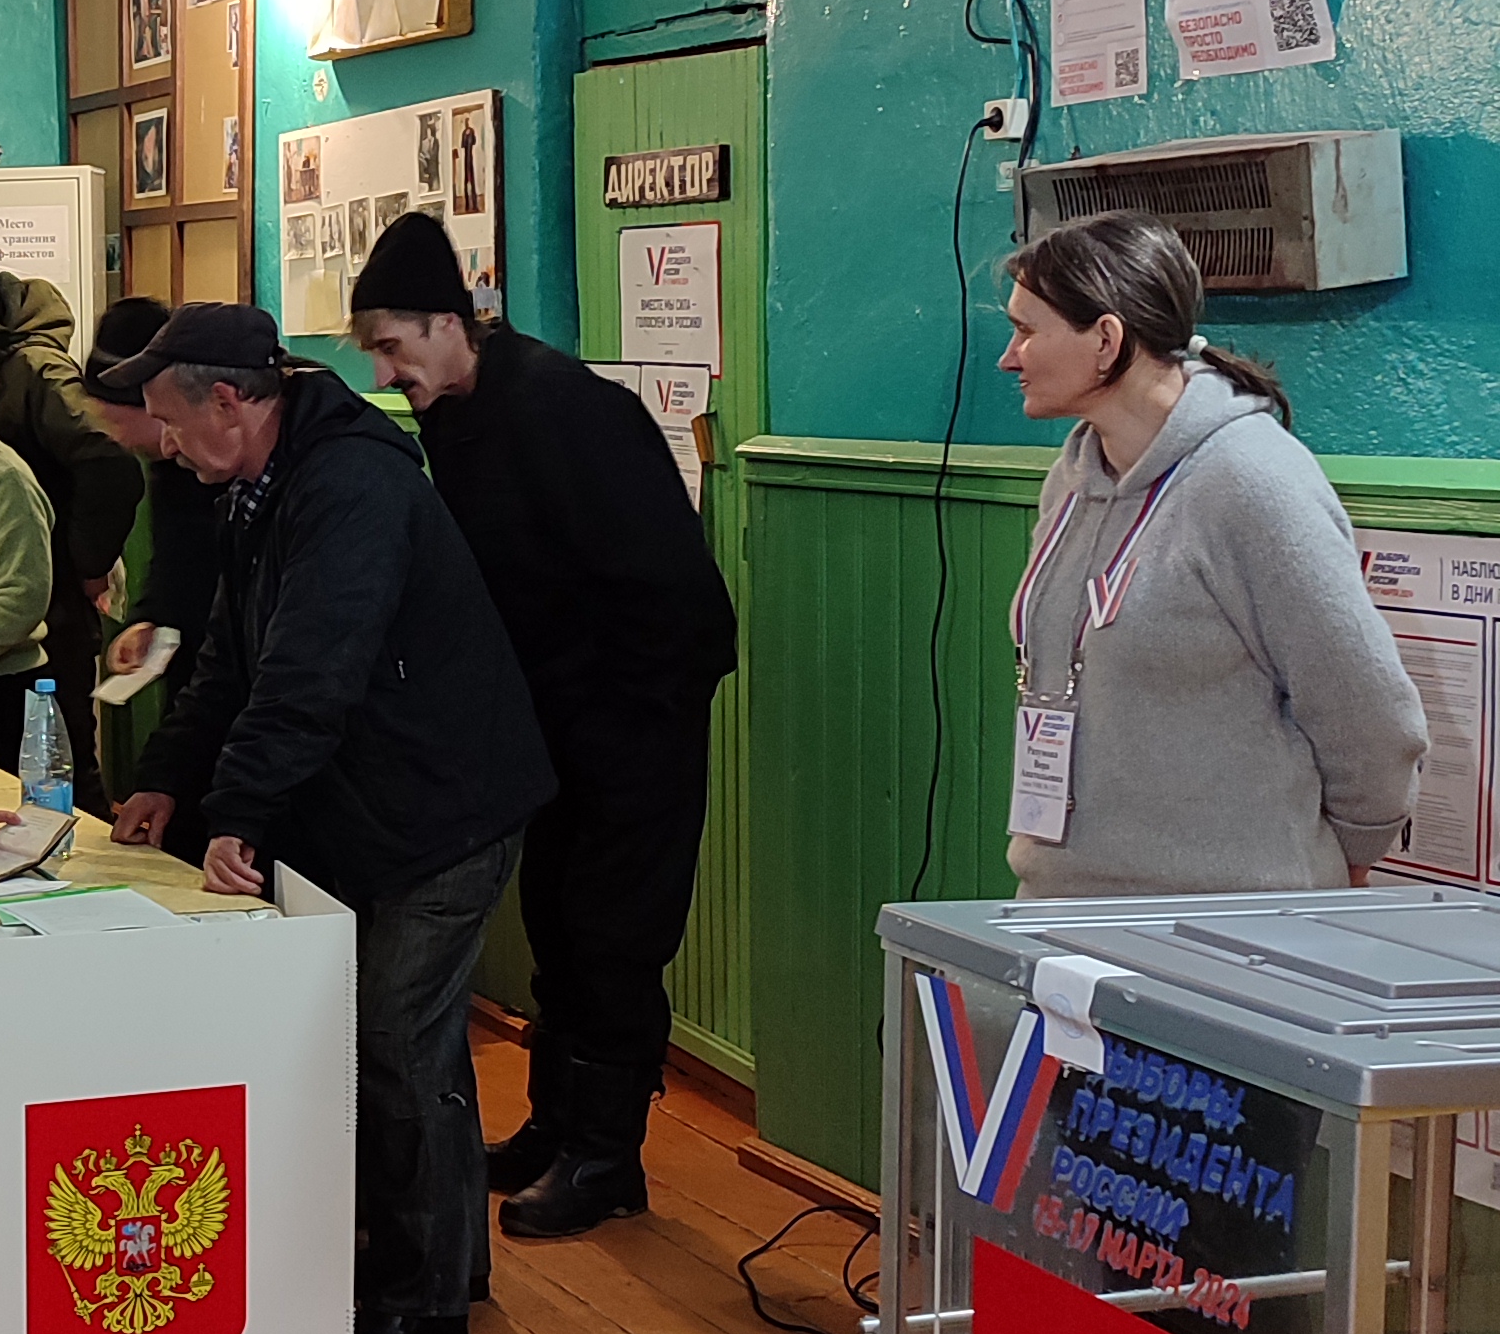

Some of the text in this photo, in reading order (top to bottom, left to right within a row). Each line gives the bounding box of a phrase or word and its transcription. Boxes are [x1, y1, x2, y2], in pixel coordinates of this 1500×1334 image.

[1178, 11, 1242, 34] БЕЗОПАСНО
[1183, 31, 1223, 48] ПРОСТО
[1190, 42, 1257, 63] НЕОБХОДИМО
[605, 151, 714, 204] ДИРЕКТОР
[2, 235, 56, 247] хранения
[1451, 583, 1493, 604] В ДНИ
[1101, 1035, 1246, 1134] ЫБОРЫ
[1066, 1088, 1296, 1234] ПРЕЗИДЕНТА
[1053, 1145, 1189, 1243] РОССИИ
[1097, 1219, 1184, 1293] МАРТА
